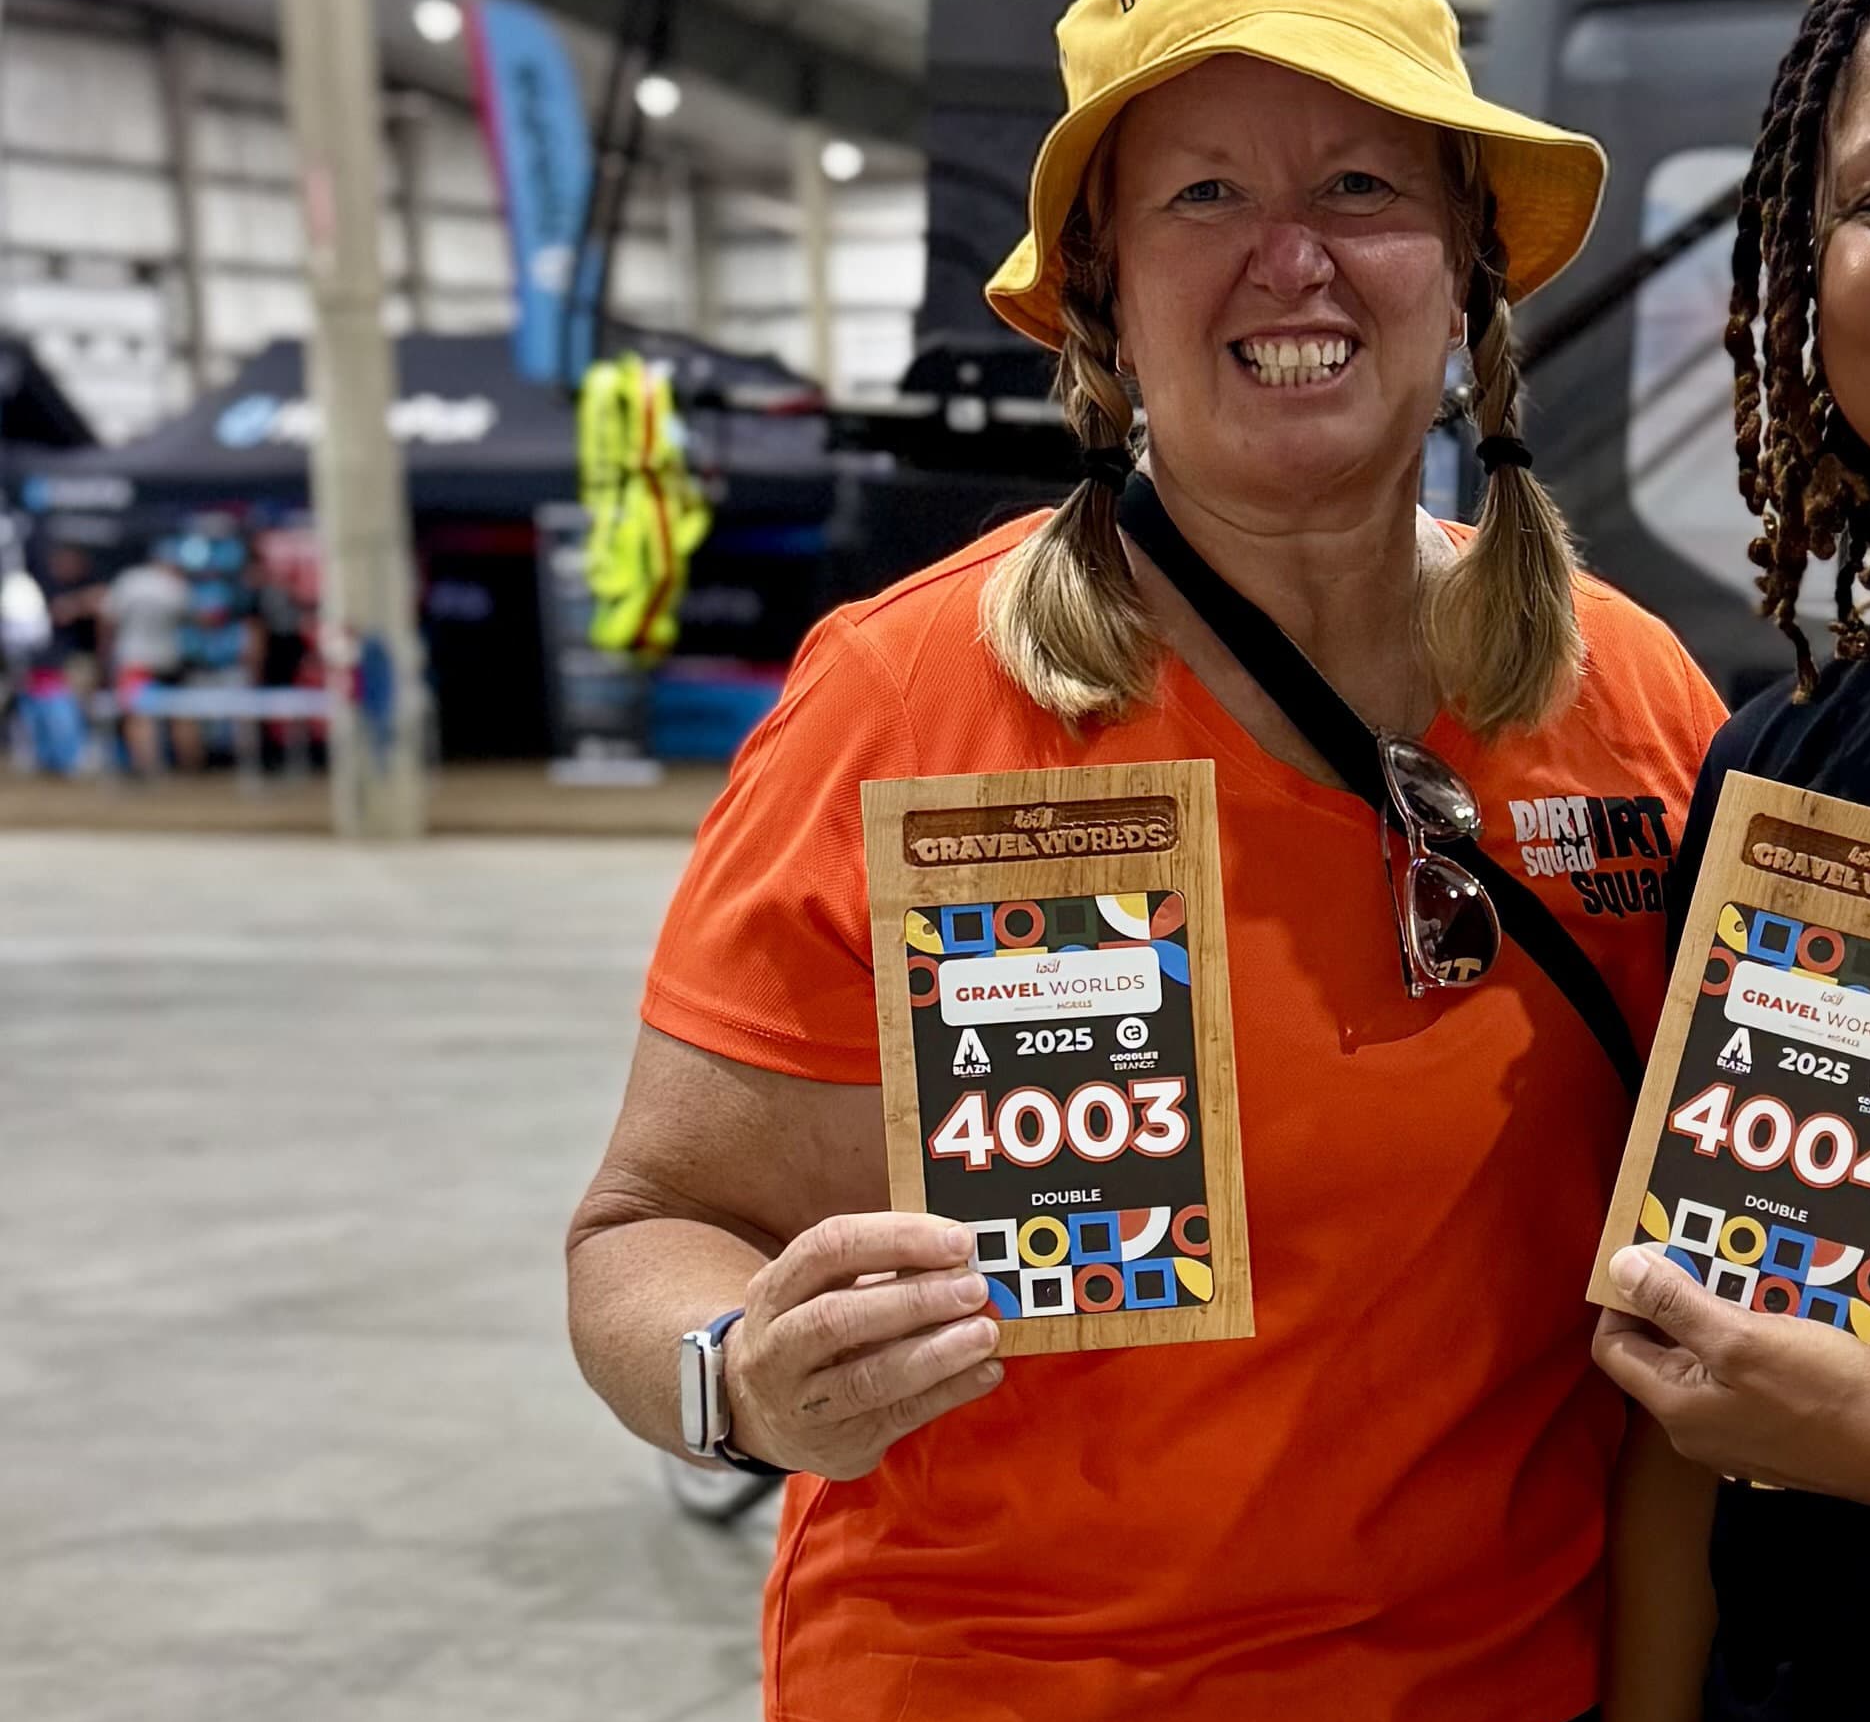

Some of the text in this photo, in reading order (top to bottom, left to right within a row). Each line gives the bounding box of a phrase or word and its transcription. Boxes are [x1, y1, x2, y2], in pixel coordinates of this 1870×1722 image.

[1508, 795, 1590, 843] DIRT
[911, 823, 1168, 862] GRAVEL WORLDS
[1752, 842, 1861, 891] GRAVEL
[955, 974, 1146, 1003] GRAVEL WORLDS
[1741, 988, 1821, 1023] GRAVEL
[1015, 1027, 1095, 1056] 2025
[1777, 1046, 1851, 1086] 2025
[928, 1075, 1192, 1173] 4003
[1031, 1187, 1103, 1208] DOUBLE
[1744, 1193, 1809, 1224] DOUBLE
